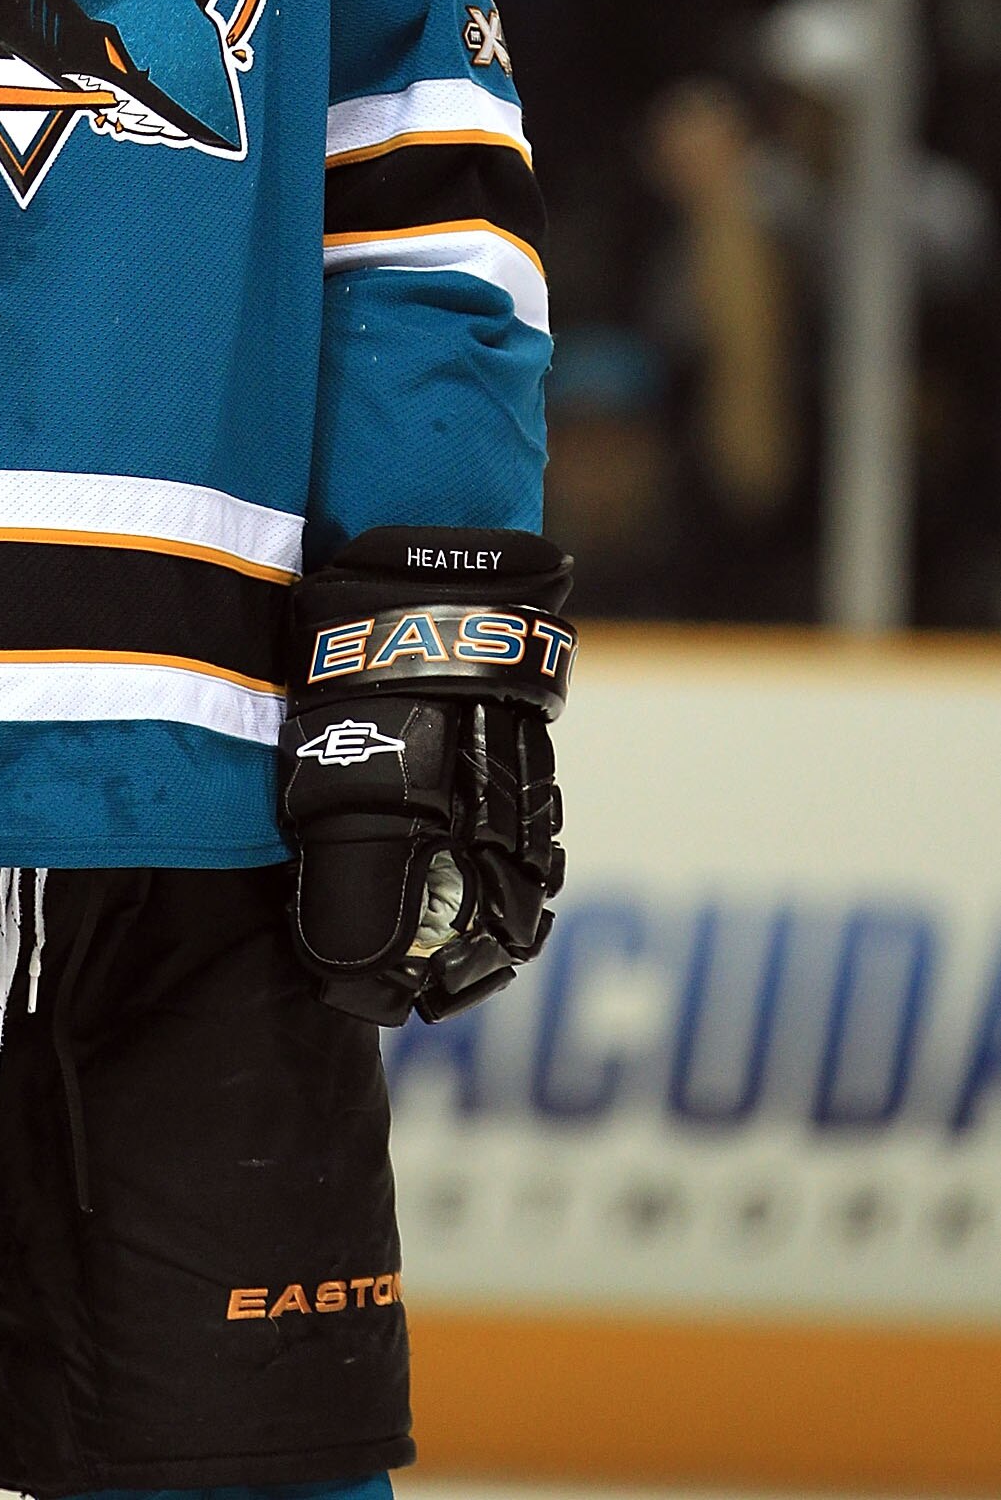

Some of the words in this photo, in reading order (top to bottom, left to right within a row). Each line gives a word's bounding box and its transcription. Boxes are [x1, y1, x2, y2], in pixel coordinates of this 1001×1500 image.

[407, 547, 502, 570] HEATLEY
[307, 611, 578, 685] EAST
[324, 728, 370, 757] E
